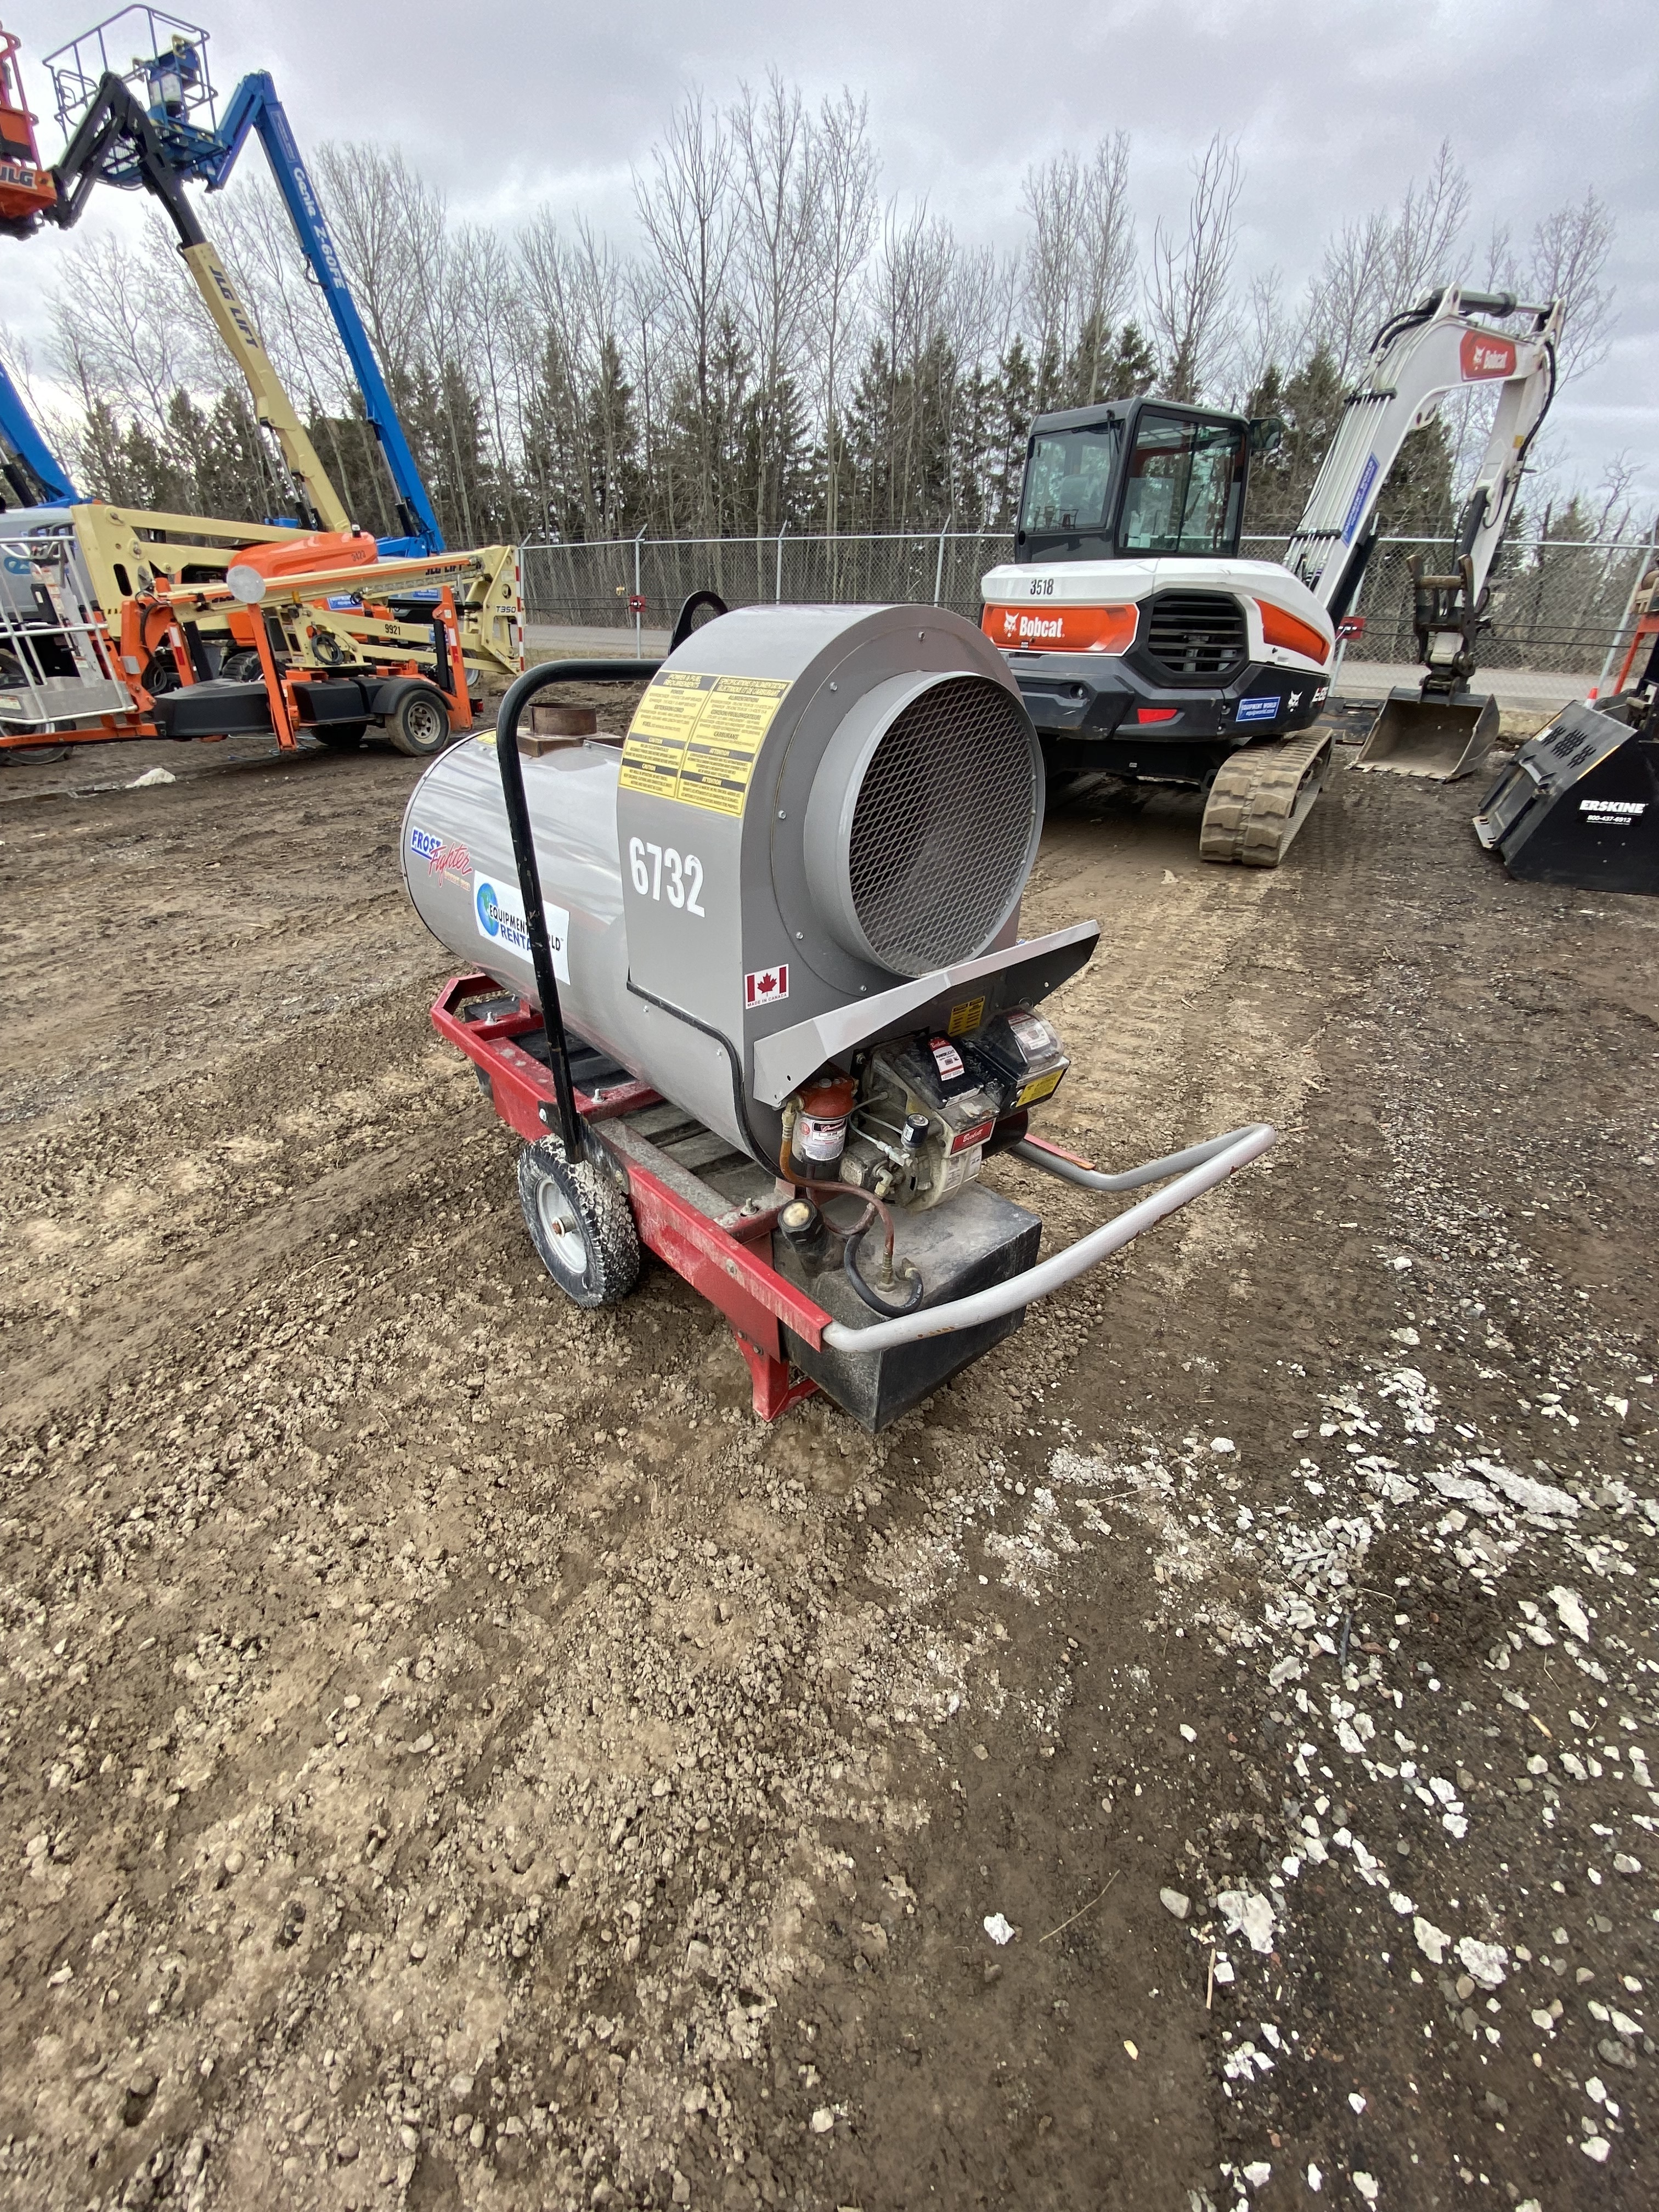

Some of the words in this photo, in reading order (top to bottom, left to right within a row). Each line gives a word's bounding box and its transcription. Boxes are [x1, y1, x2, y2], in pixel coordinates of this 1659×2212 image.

[294, 167, 317, 216] Genie
[313, 225, 346, 289] Z-60FE
[208, 265, 235, 301] JLG
[229, 307, 259, 349] LIFT
[1483, 350, 1508, 370] Bobcat
[1030, 578, 1054, 596] 3518
[385, 623, 401, 636] 9921
[1019, 616, 1063, 638] Bobcat
[1579, 799, 1646, 814] ERSKINE
[411, 828, 442, 857] FROST
[428, 842, 472, 887] Fighter
[629, 837, 706, 918] 6732
[500, 924, 532, 951] RENTA
[768, 993, 787, 1001] CANADA
